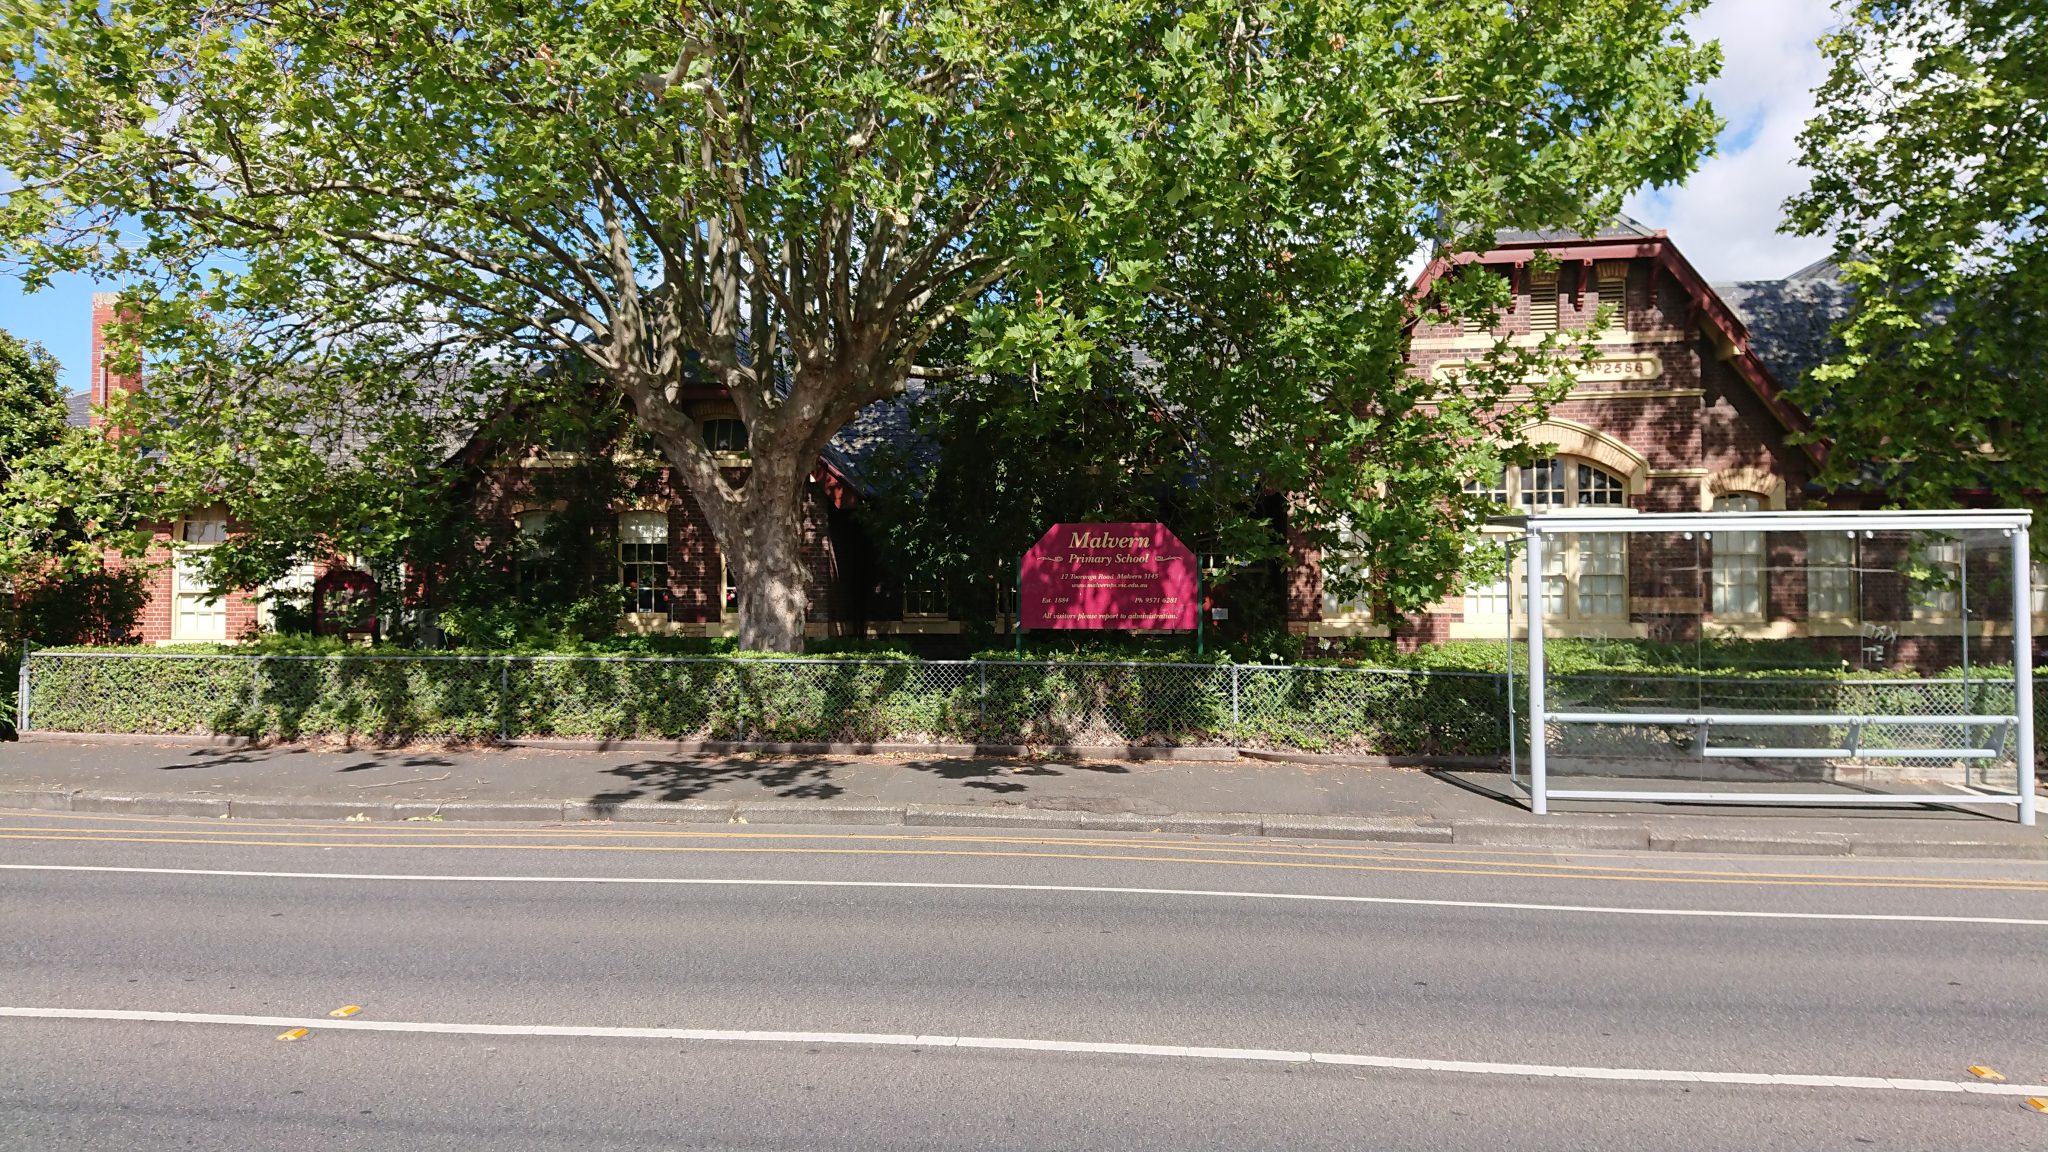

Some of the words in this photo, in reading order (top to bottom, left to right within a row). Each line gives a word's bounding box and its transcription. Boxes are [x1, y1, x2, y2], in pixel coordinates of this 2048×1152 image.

[1603, 362, 1644, 374] 2586
[1068, 532, 1150, 549] Malvern
[1068, 553, 1112, 566] Primary
[1114, 553, 1149, 564] School
[1078, 612, 1098, 621] please
[1100, 612, 1119, 621] report
[1128, 612, 1178, 620] administration.
